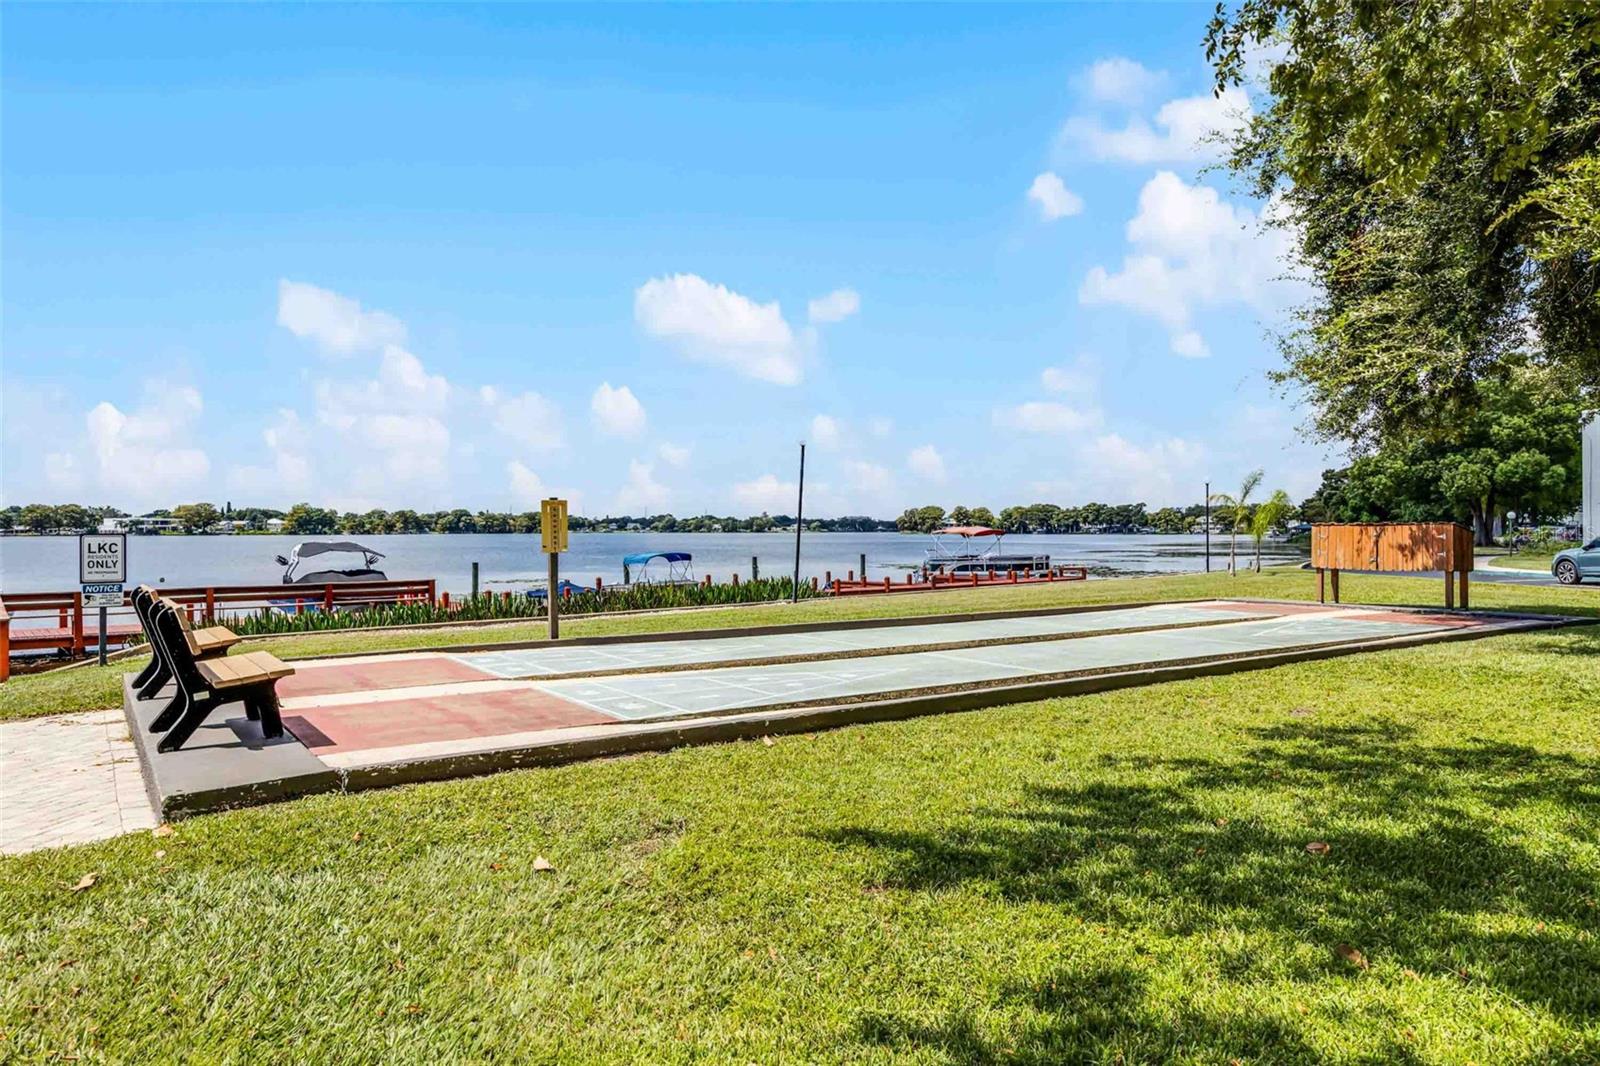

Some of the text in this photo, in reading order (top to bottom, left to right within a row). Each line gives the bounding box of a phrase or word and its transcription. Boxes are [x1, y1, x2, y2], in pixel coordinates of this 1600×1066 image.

[87, 543, 119, 554] LKC
[87, 560, 119, 569] ONLY
[85, 585, 121, 593] NOTICE
